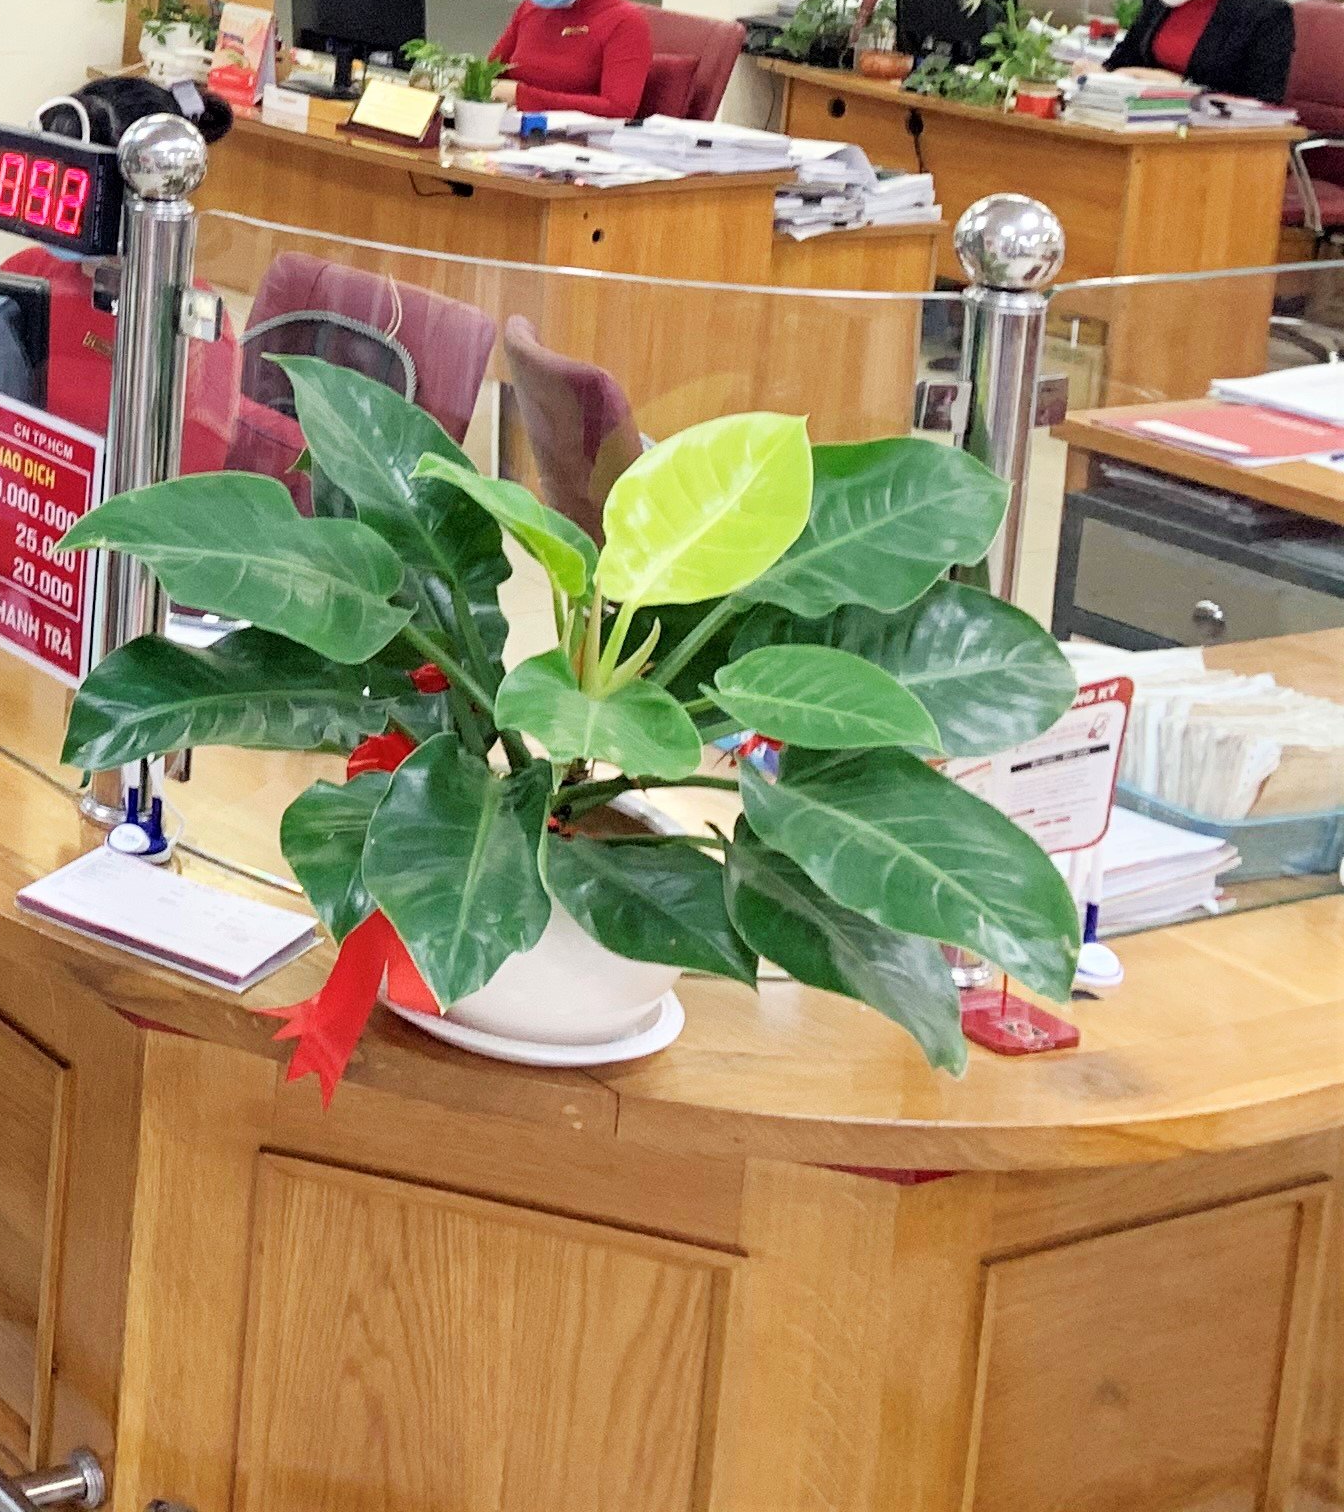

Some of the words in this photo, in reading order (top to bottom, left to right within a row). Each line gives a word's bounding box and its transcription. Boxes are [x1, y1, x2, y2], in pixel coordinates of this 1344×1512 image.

[14, 422, 30, 441] CN
[24, 456, 56, 489] DỊCH
[13, 556, 74, 608] 20.000
